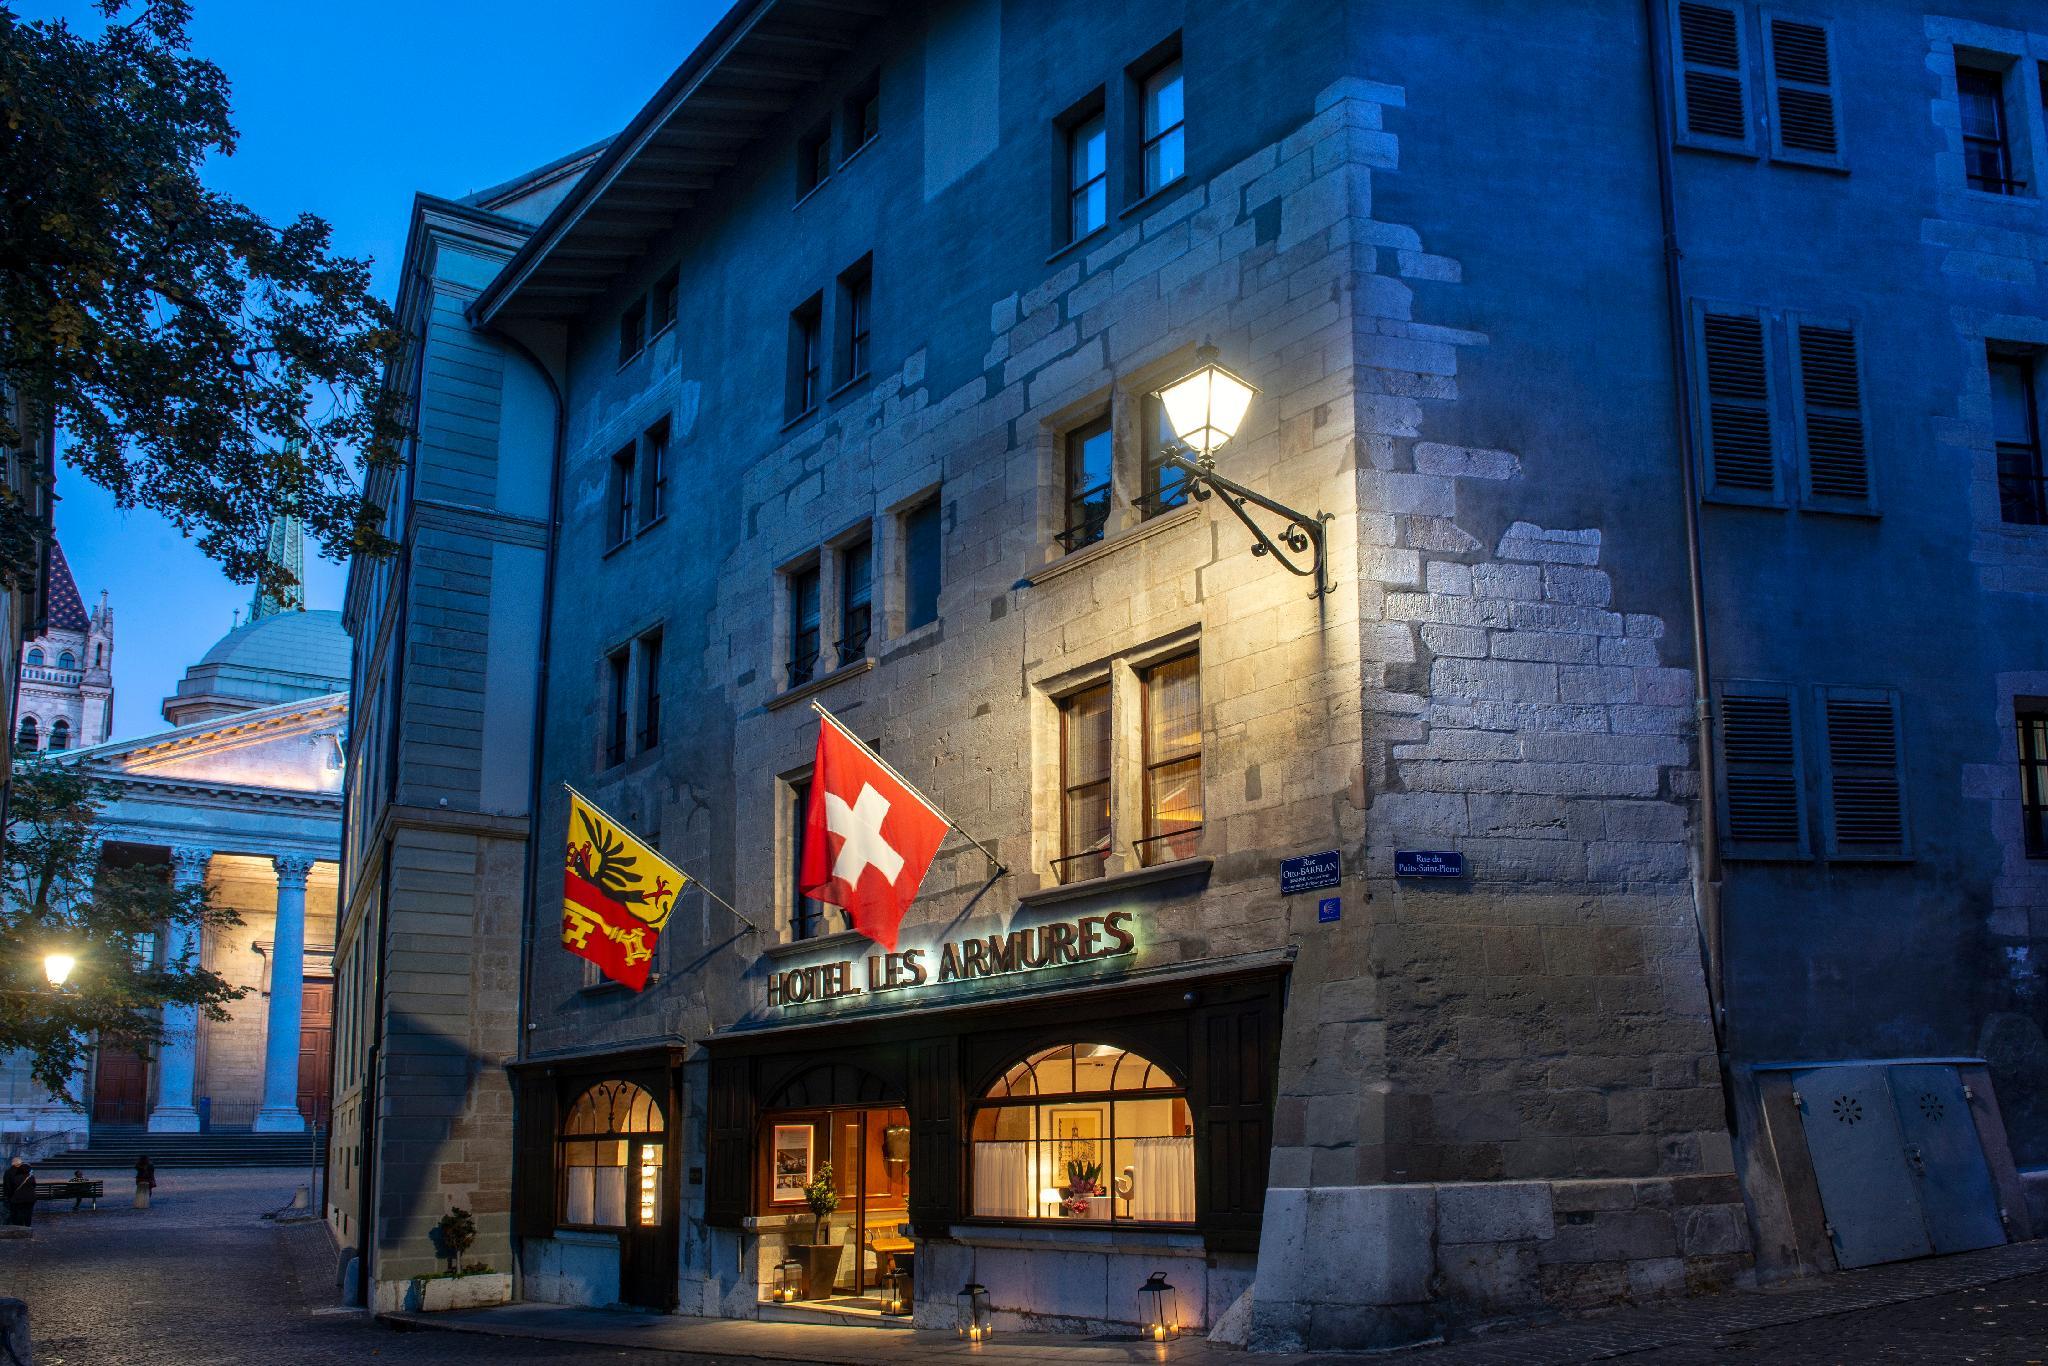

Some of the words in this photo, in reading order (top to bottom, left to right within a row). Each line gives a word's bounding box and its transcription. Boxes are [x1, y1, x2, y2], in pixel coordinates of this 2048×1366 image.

[1302, 859, 1316, 867] Rue
[1416, 854, 1430, 863] Rue
[1432, 854, 1442, 863] du
[1399, 863, 1460, 873] Puits-Saint-Pierre
[768, 961, 862, 1007] HOTEL
[868, 949, 928, 992] LES
[938, 911, 1135, 983] ARMURES
